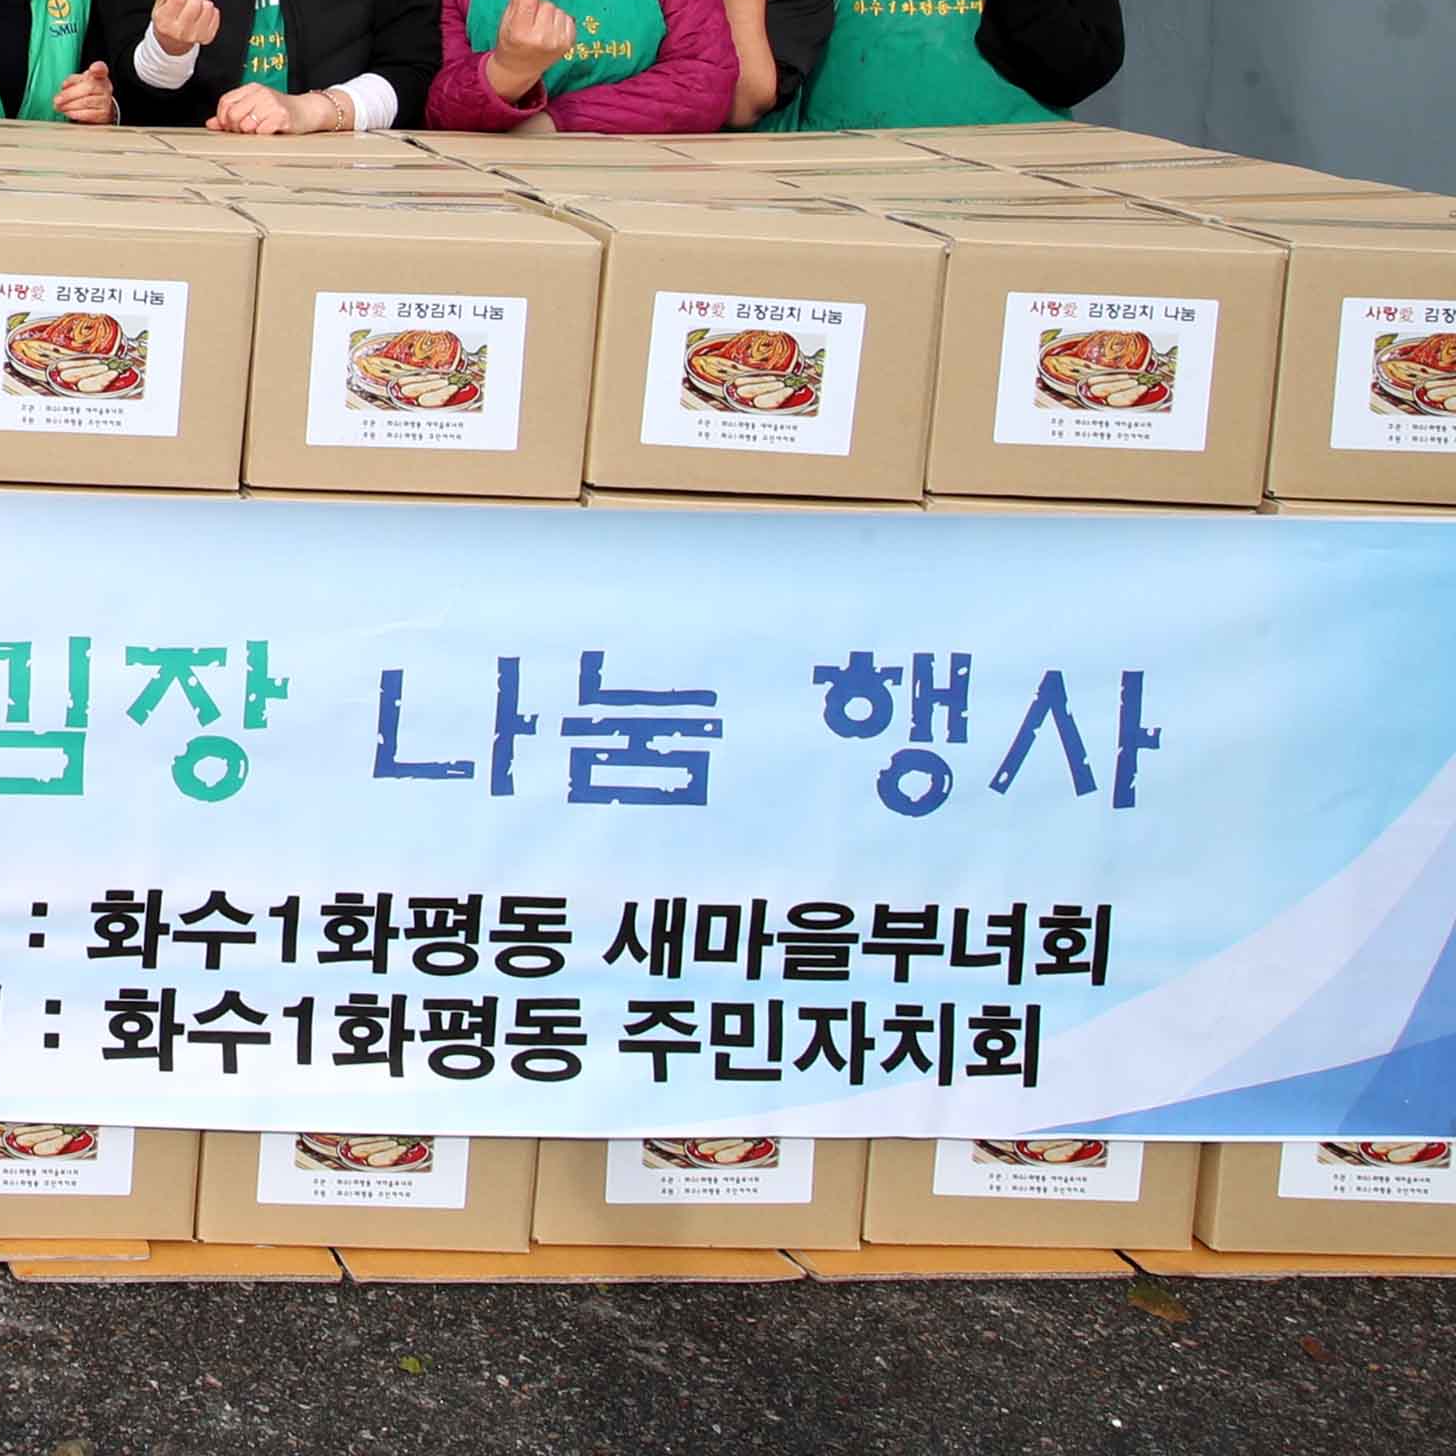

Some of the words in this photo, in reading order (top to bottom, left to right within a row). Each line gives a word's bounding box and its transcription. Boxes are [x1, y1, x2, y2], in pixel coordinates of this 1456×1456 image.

[57, 286, 122, 304] 김장김치
[133, 290, 165, 306] 나눔
[397, 303, 462, 320] 김장김치
[473, 305, 504, 321] 나눔
[737, 304, 801, 322] 김장김치
[811, 308, 842, 325] 나눔
[1089, 303, 1154, 321] 김장김치
[1164, 307, 1196, 323] 나눔
[373, 650, 724, 806] 나눔
[812, 650, 1162, 818] 행사
[86, 889, 573, 978] 화수1화평동
[603, 896, 1112, 985] 새마을부녀회
[102, 987, 587, 1081] 화수1화평동
[619, 998, 1043, 1087] 주민자치회
